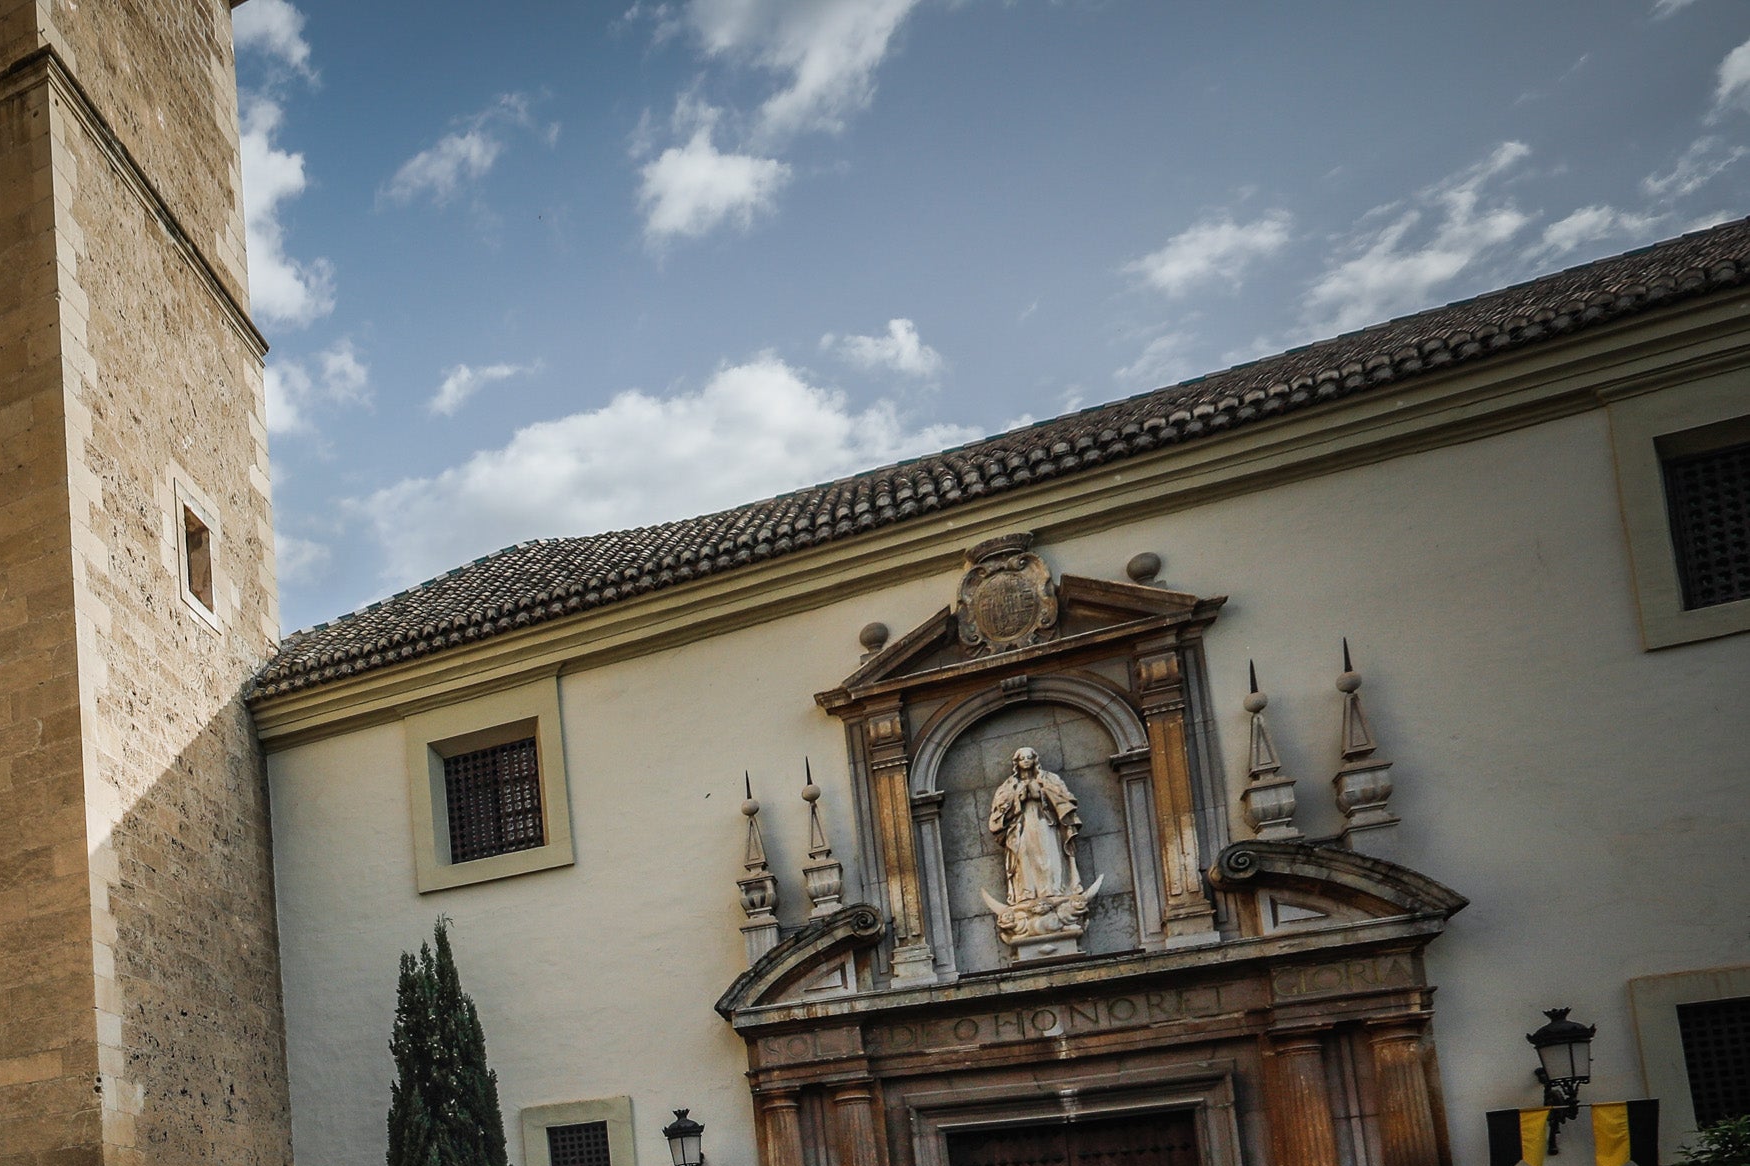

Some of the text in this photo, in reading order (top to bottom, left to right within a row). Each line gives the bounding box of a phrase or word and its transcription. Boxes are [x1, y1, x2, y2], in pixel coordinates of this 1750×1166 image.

[889, 1018, 979, 1049] DEO
[993, 992, 1176, 1039] HONOR
[1273, 958, 1413, 996] GLORIA
